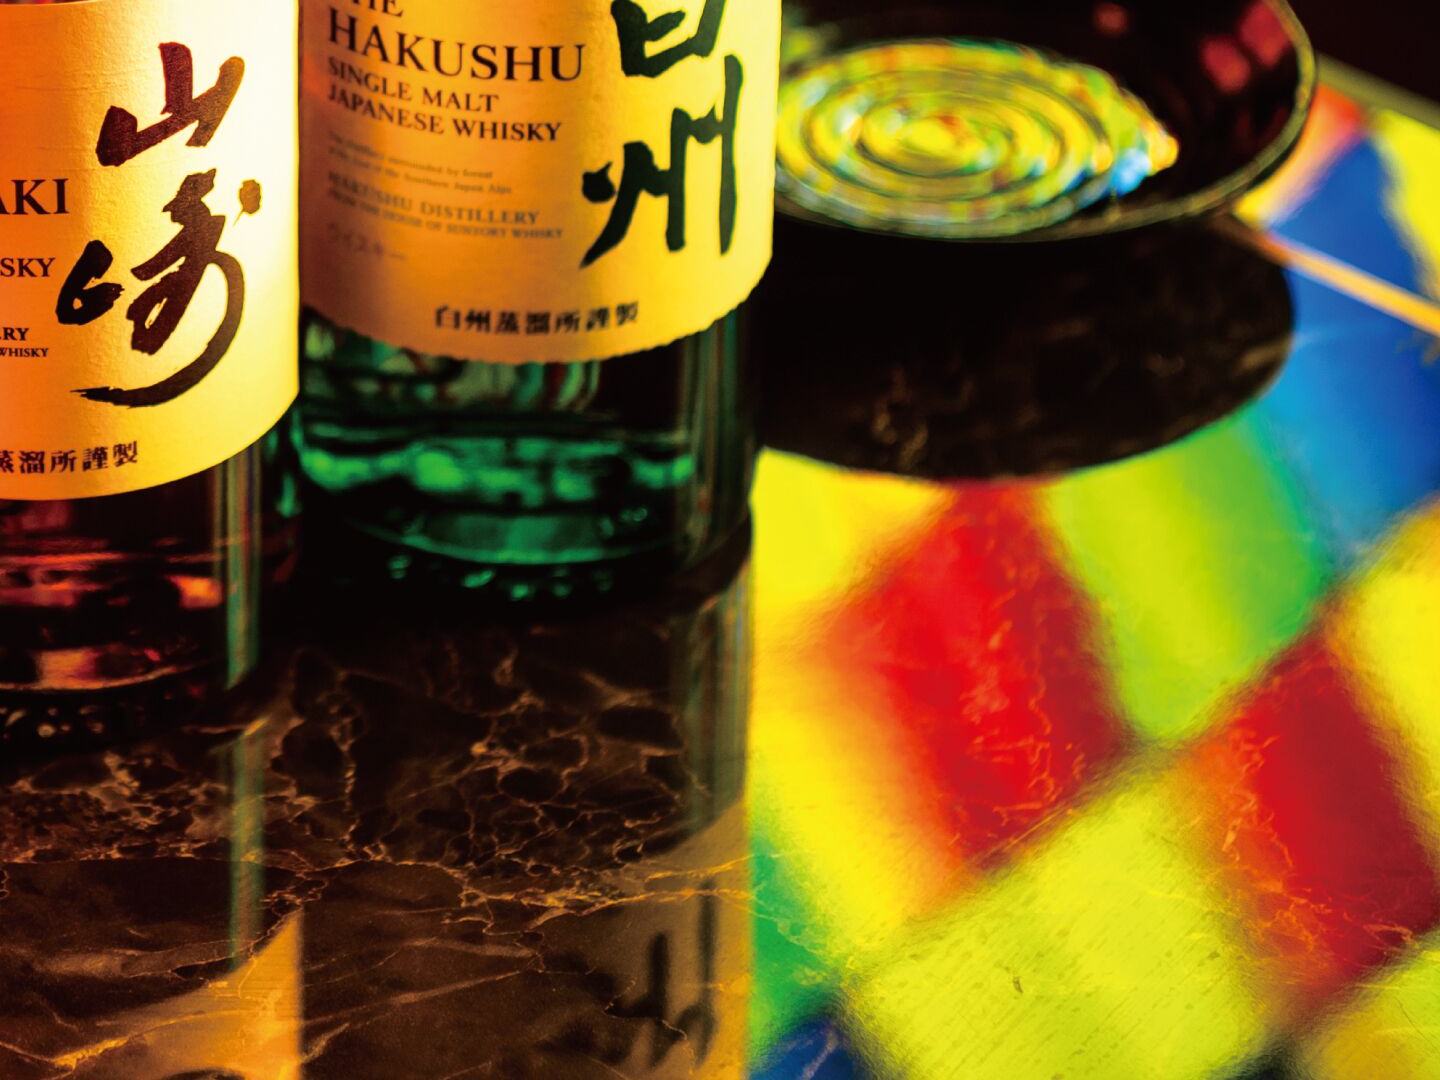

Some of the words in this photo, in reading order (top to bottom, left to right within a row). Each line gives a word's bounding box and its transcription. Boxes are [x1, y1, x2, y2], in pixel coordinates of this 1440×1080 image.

[328, 7, 587, 82] HAKUSHU
[328, 56, 412, 102] SINGLE
[422, 87, 500, 114] MALT
[328, 85, 444, 135] JAPANESE
[453, 118, 562, 143] WHISKY
[420, 200, 541, 225] DISTILLERY
